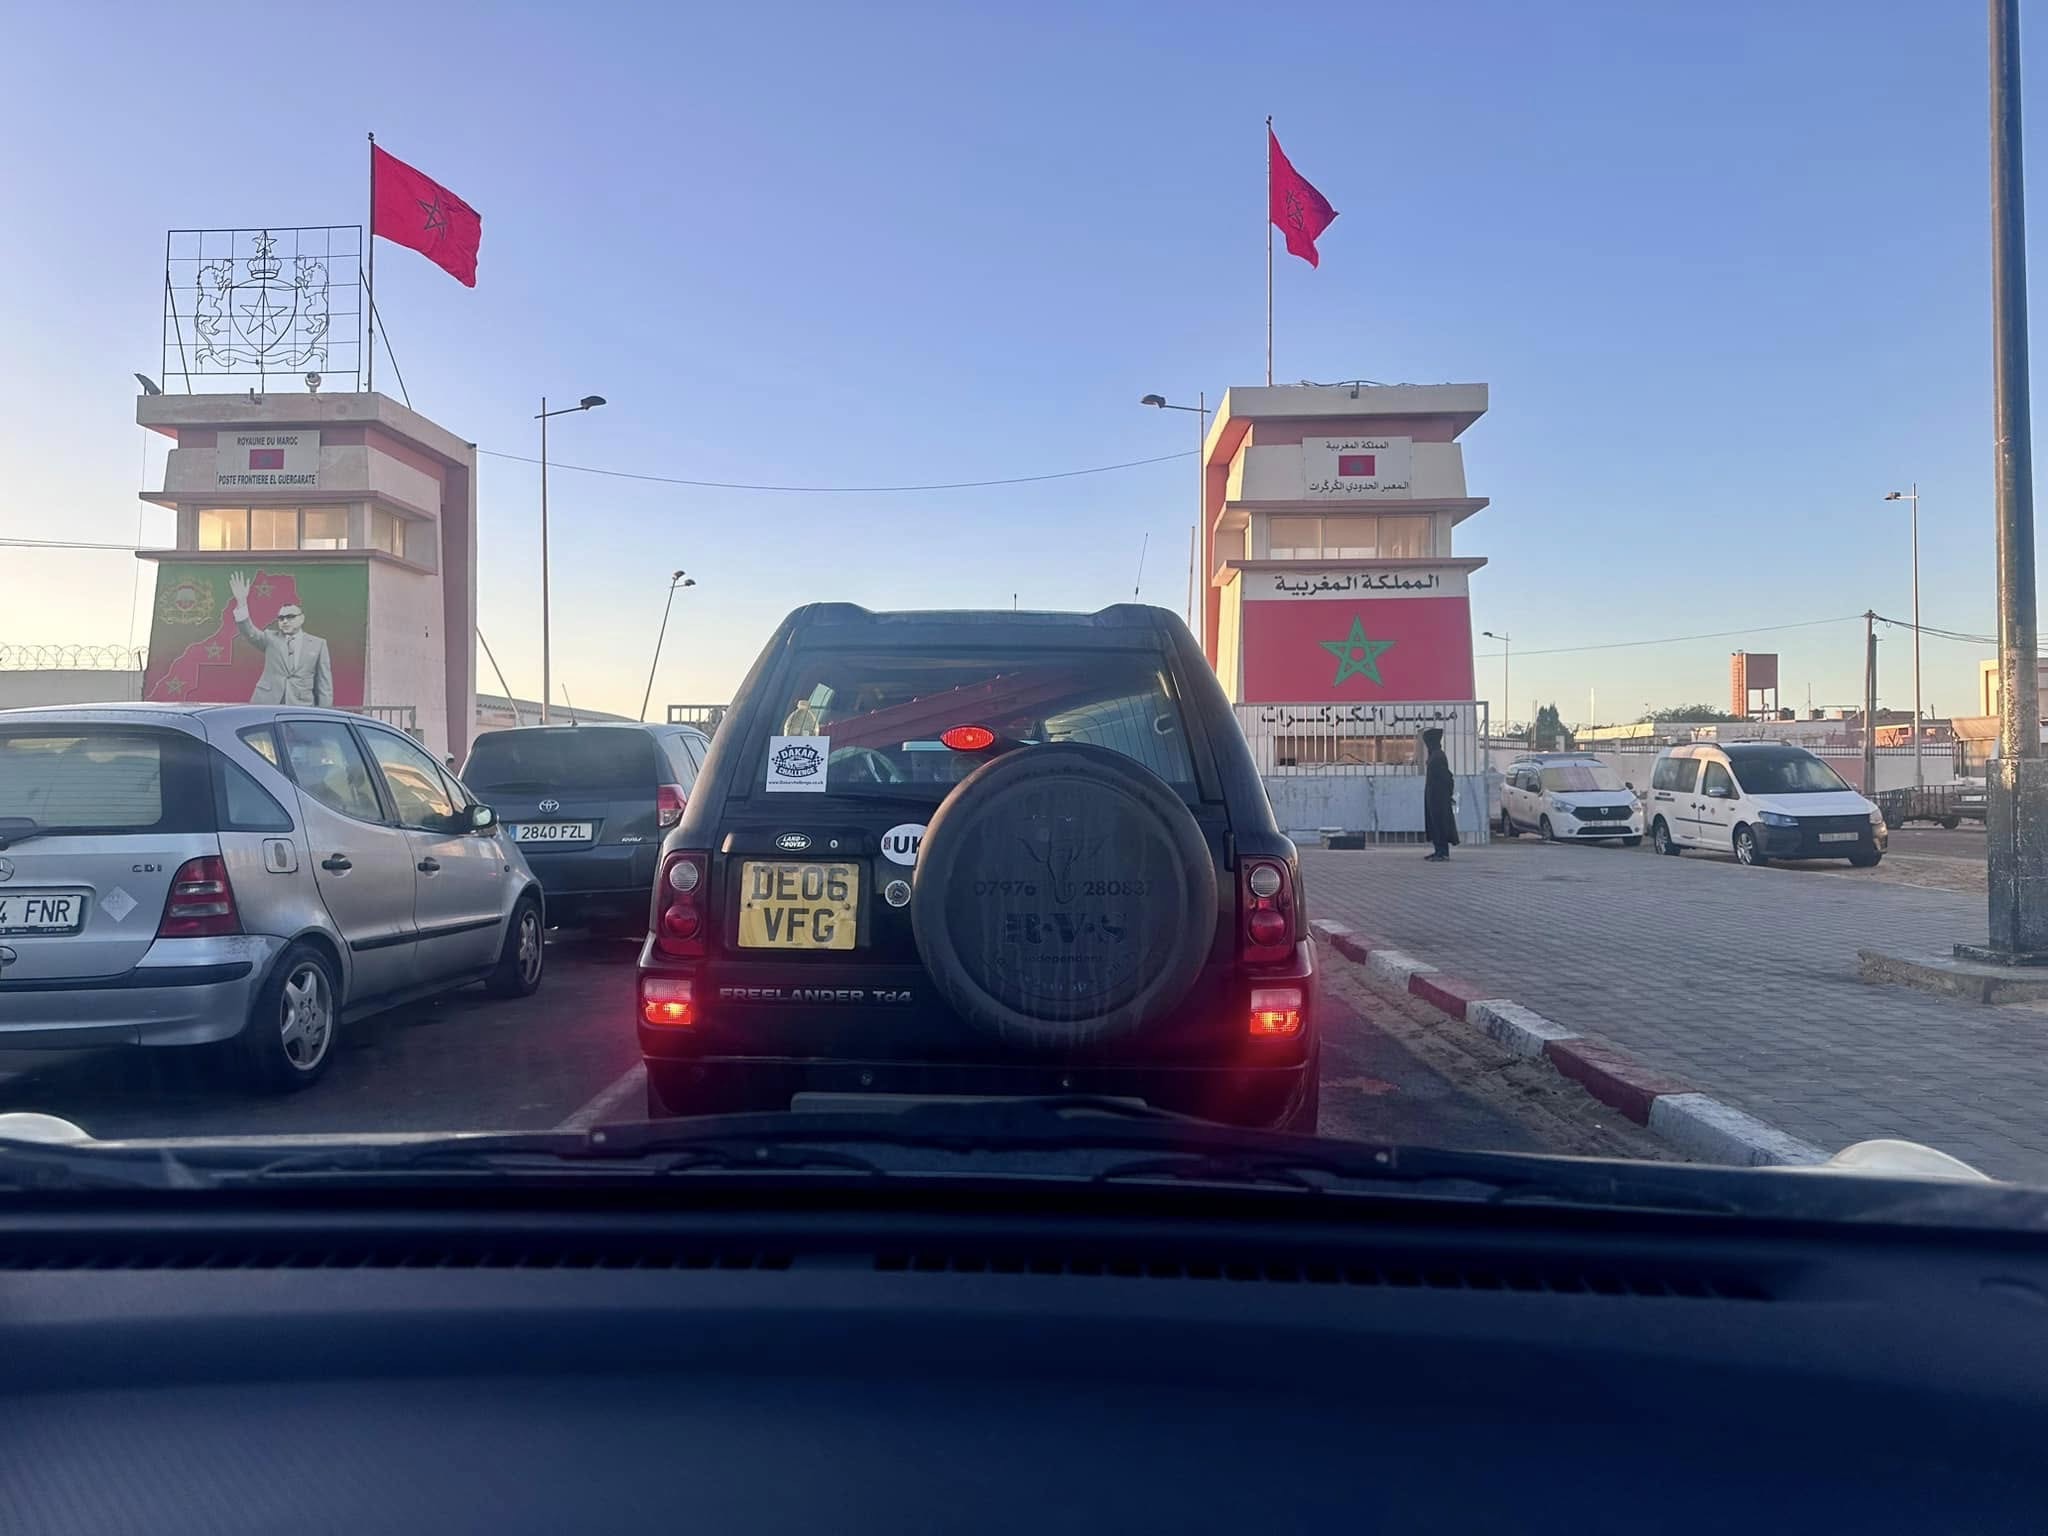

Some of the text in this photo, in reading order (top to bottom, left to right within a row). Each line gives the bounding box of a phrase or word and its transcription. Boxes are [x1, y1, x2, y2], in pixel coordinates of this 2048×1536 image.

[237, 436, 298, 446] ROYAUME DU MAROC
[1326, 440, 1389, 452] المملكة المغربية
[218, 474, 237, 485] POSTE
[270, 474, 277, 485] EL
[1381, 480, 1409, 493] المعبر
[1275, 573, 1440, 596] المملكة المغربية
[1386, 711, 1458, 728] معبر
[780, 748, 815, 760] DAKAR
[777, 767, 816, 777] CHALLENGE
[521, 824, 586, 840] 2840 FZL
[131, 864, 163, 873] CDI
[751, 865, 849, 901] DE06
[24, 900, 71, 923] FNR
[763, 907, 835, 943] VFG
[719, 987, 913, 1002] FREELANDER Td4
